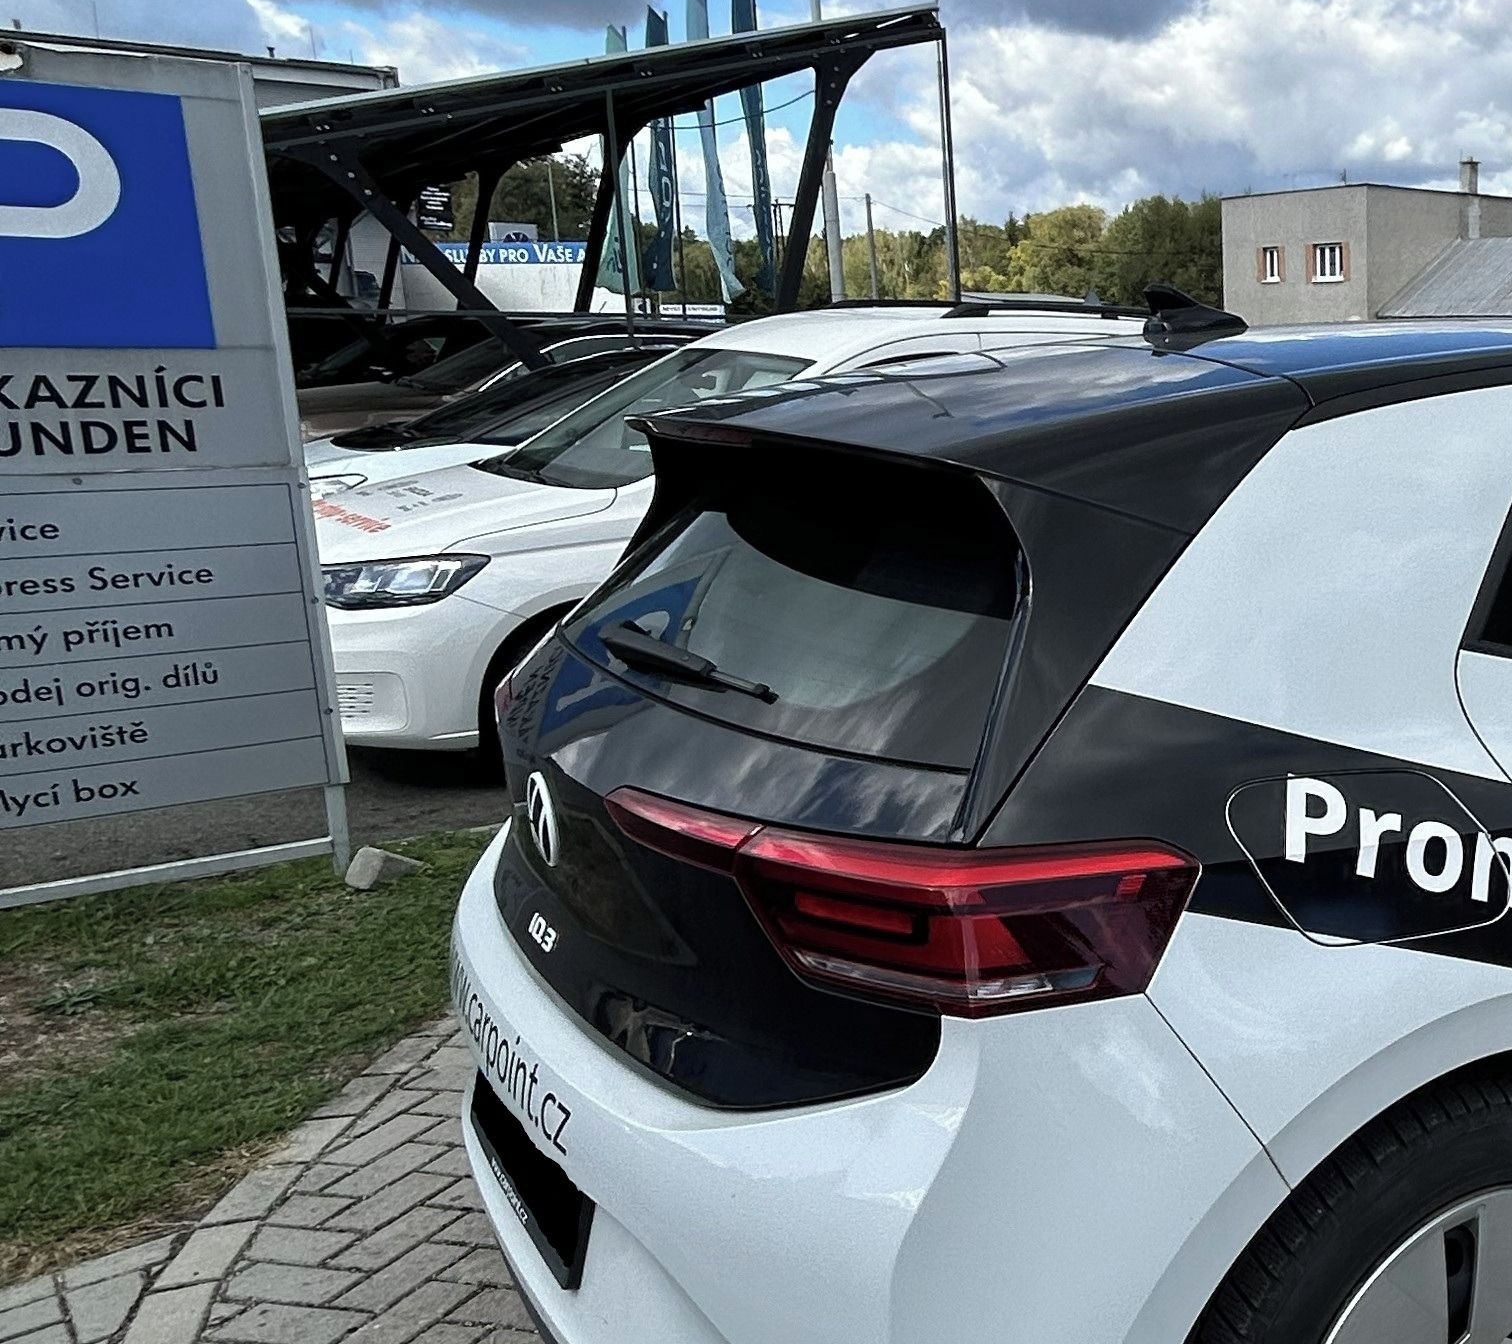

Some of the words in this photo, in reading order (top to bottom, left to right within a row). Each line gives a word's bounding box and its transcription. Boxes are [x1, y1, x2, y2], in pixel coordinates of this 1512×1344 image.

[442, 248, 495, 263] SLUBY
[501, 249, 528, 263] PRO
[532, 243, 573, 263] VAŠE
[0, 576, 75, 597] ress
[88, 566, 214, 592] Service
[63, 619, 174, 652] příjem
[76, 672, 151, 699] orig.
[162, 662, 219, 690] dílů
[73, 779, 140, 803] box
